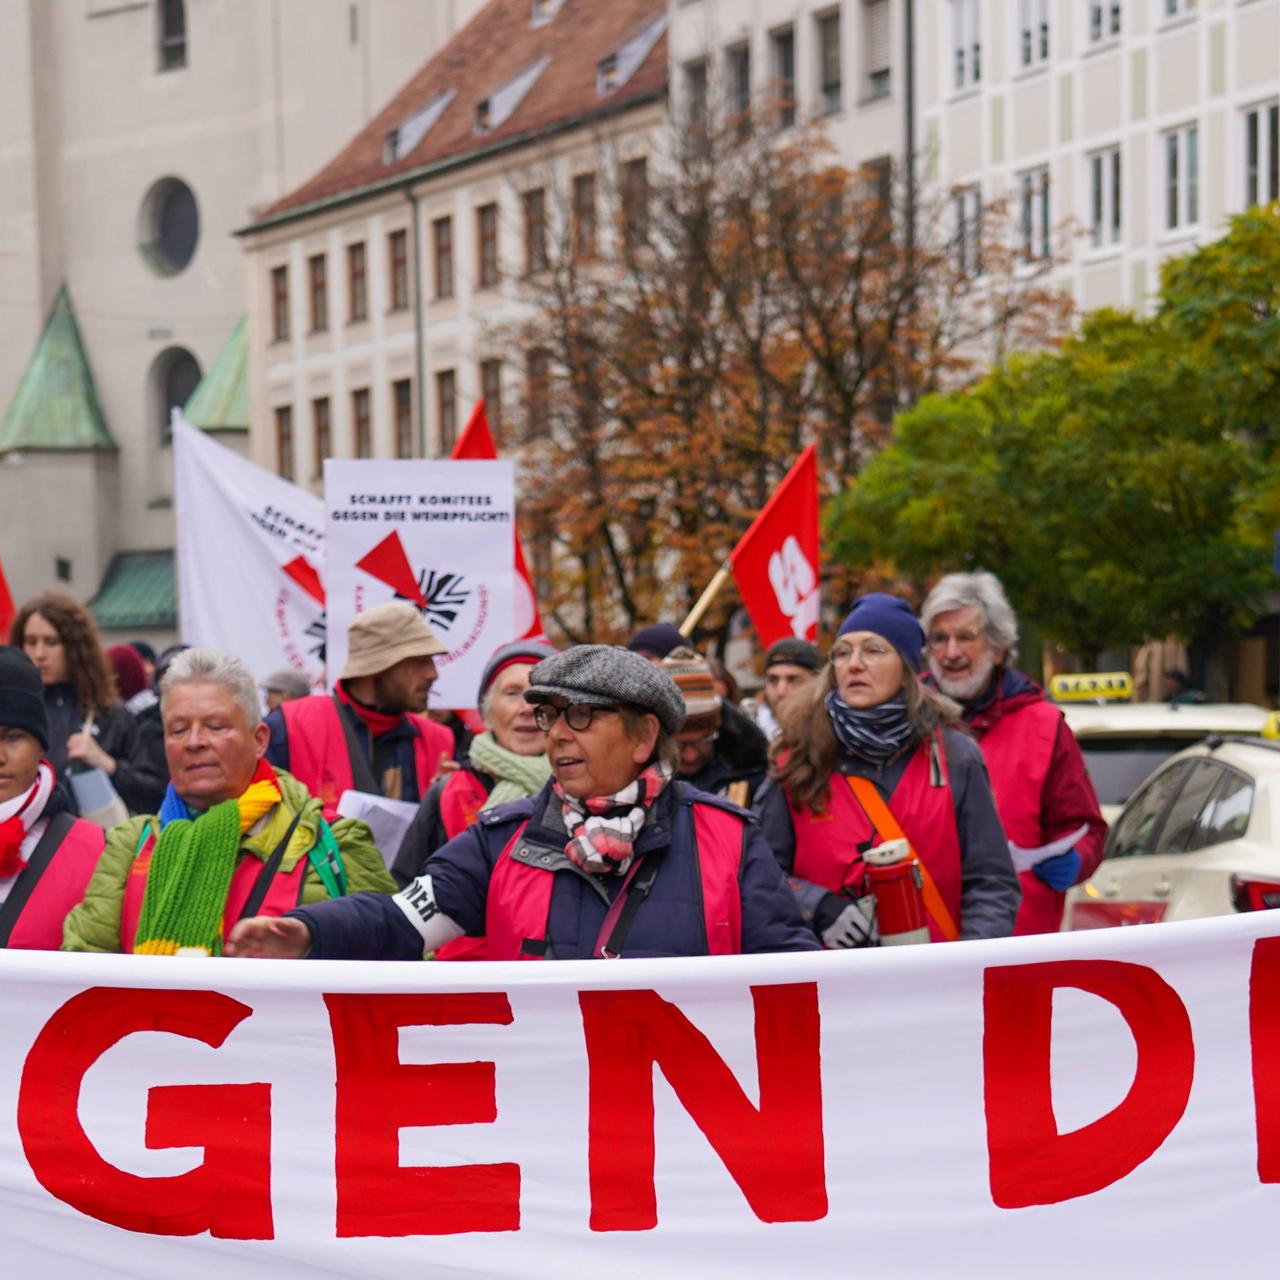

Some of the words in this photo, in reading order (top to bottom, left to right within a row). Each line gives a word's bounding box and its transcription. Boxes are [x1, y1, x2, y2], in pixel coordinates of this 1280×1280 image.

[349, 494, 412, 506] SCHAFFT
[419, 494, 492, 506] KOMITEES
[331, 510, 379, 522] GEGEN
[383, 510, 406, 522] DIE
